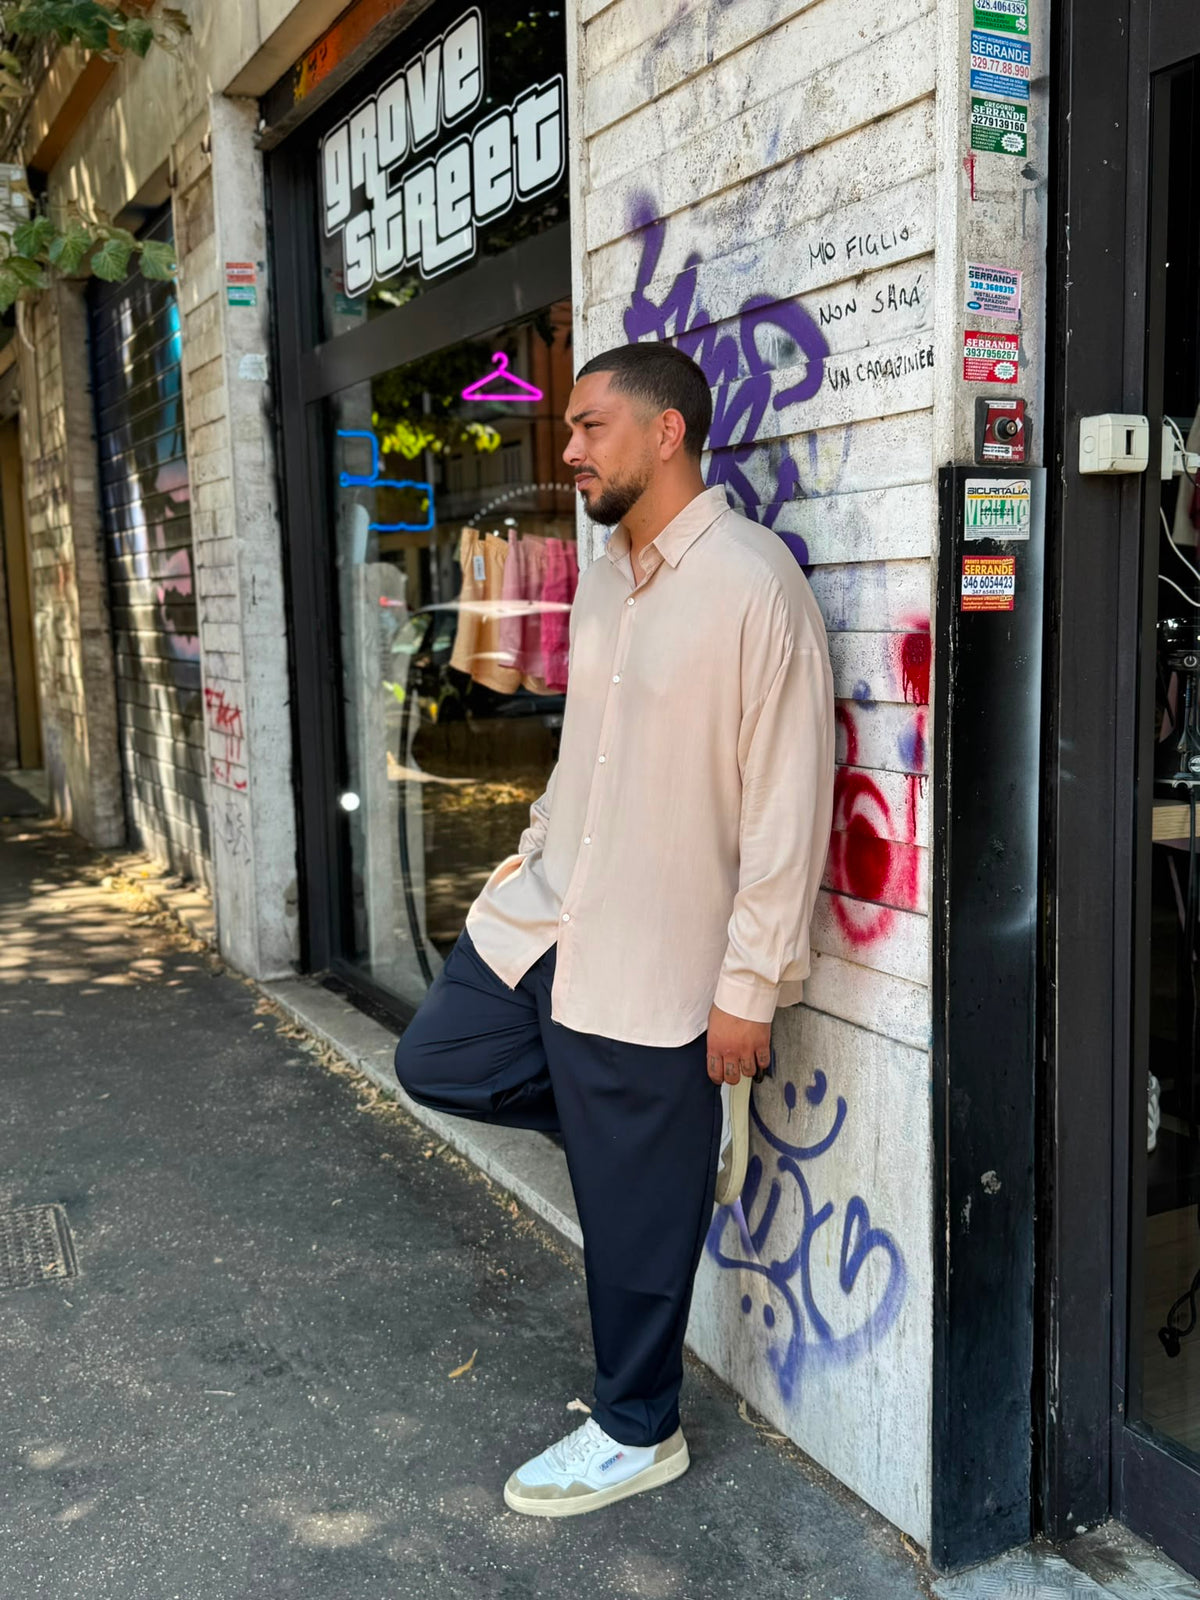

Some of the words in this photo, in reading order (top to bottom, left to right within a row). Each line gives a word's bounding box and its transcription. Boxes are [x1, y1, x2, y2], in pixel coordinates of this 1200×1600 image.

[972, 40, 1029, 63] SERRANDE
[972, 55, 1029, 78] 329.77.88.990
[973, 104, 1026, 122] SERRANDE
[983, 100, 1016, 112] GREGORIO
[972, 114, 1025, 132] 3279139160
[809, 237, 836, 269] MIO
[846, 227, 910, 260] FIGLIO
[968, 270, 1018, 285] SERRANDE
[819, 298, 857, 326] NON
[966, 338, 1017, 350] SERRANDE
[965, 348, 1017, 360] 3937956267
[828, 366, 850, 391] UN
[967, 487, 1029, 495] SICURITALIA
[964, 564, 1013, 576] SERRANDE
[963, 576, 979, 589] 346
[979, 576, 1013, 589] 6054423
